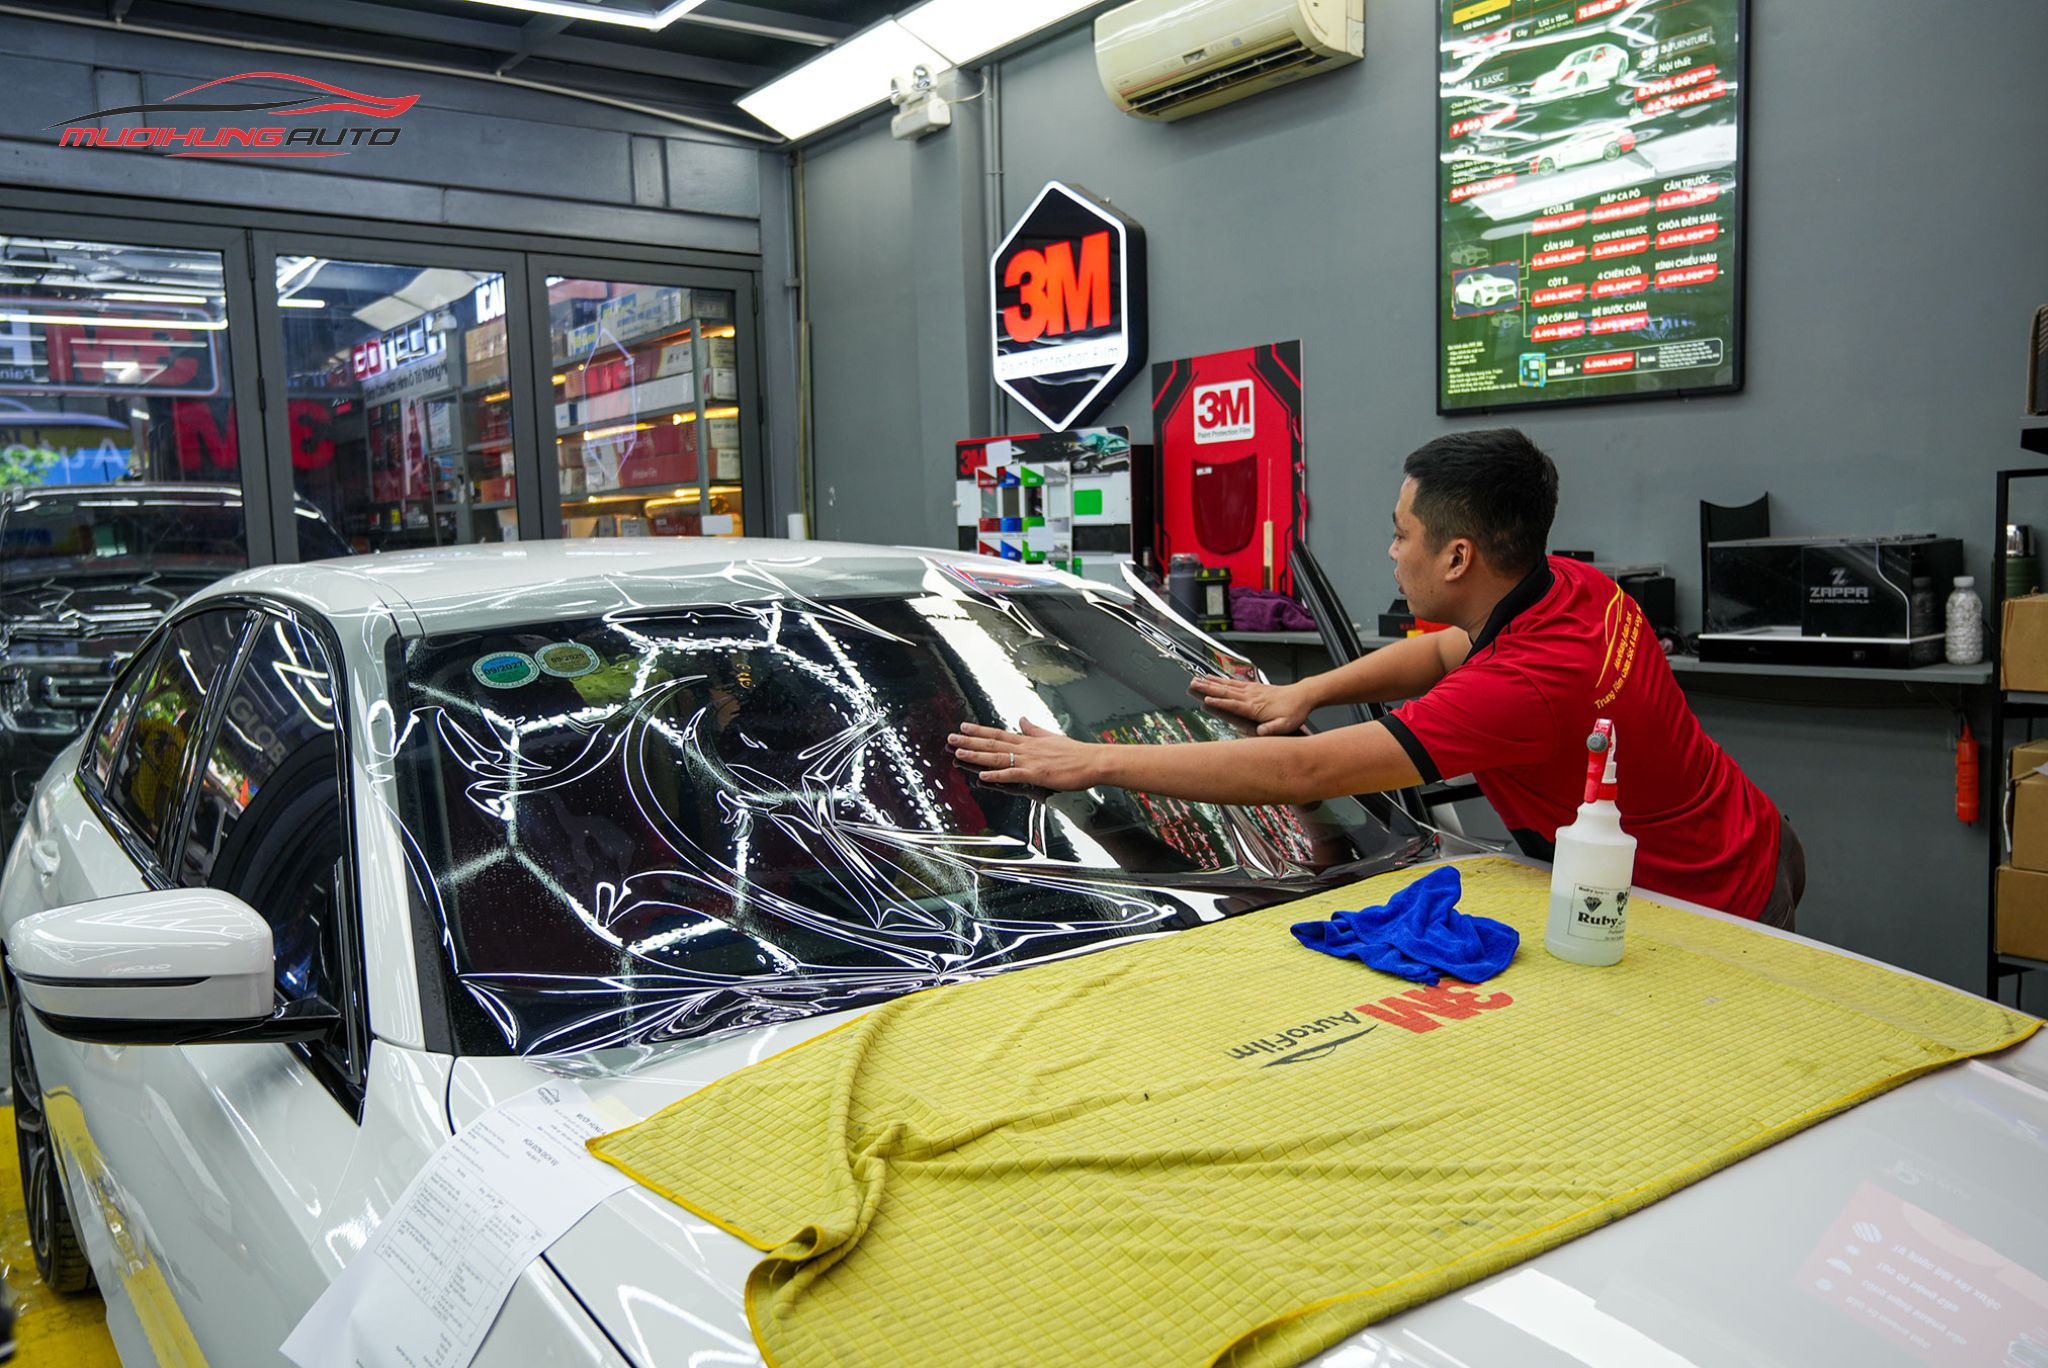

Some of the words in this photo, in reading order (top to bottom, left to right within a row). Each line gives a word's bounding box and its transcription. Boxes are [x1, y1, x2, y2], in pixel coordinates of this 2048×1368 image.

[1003, 231, 1111, 343] 3M
[1197, 386, 1250, 430] 3M
[1198, 431, 1211, 439] Paint
[1211, 428, 1239, 438] Protection
[1239, 426, 1251, 435] Film
[1810, 586, 1869, 598] ZAPPA
[1594, 690, 1616, 709] Trung
[1577, 911, 1618, 928] Ruby
[1354, 979, 1515, 1034] 3M
